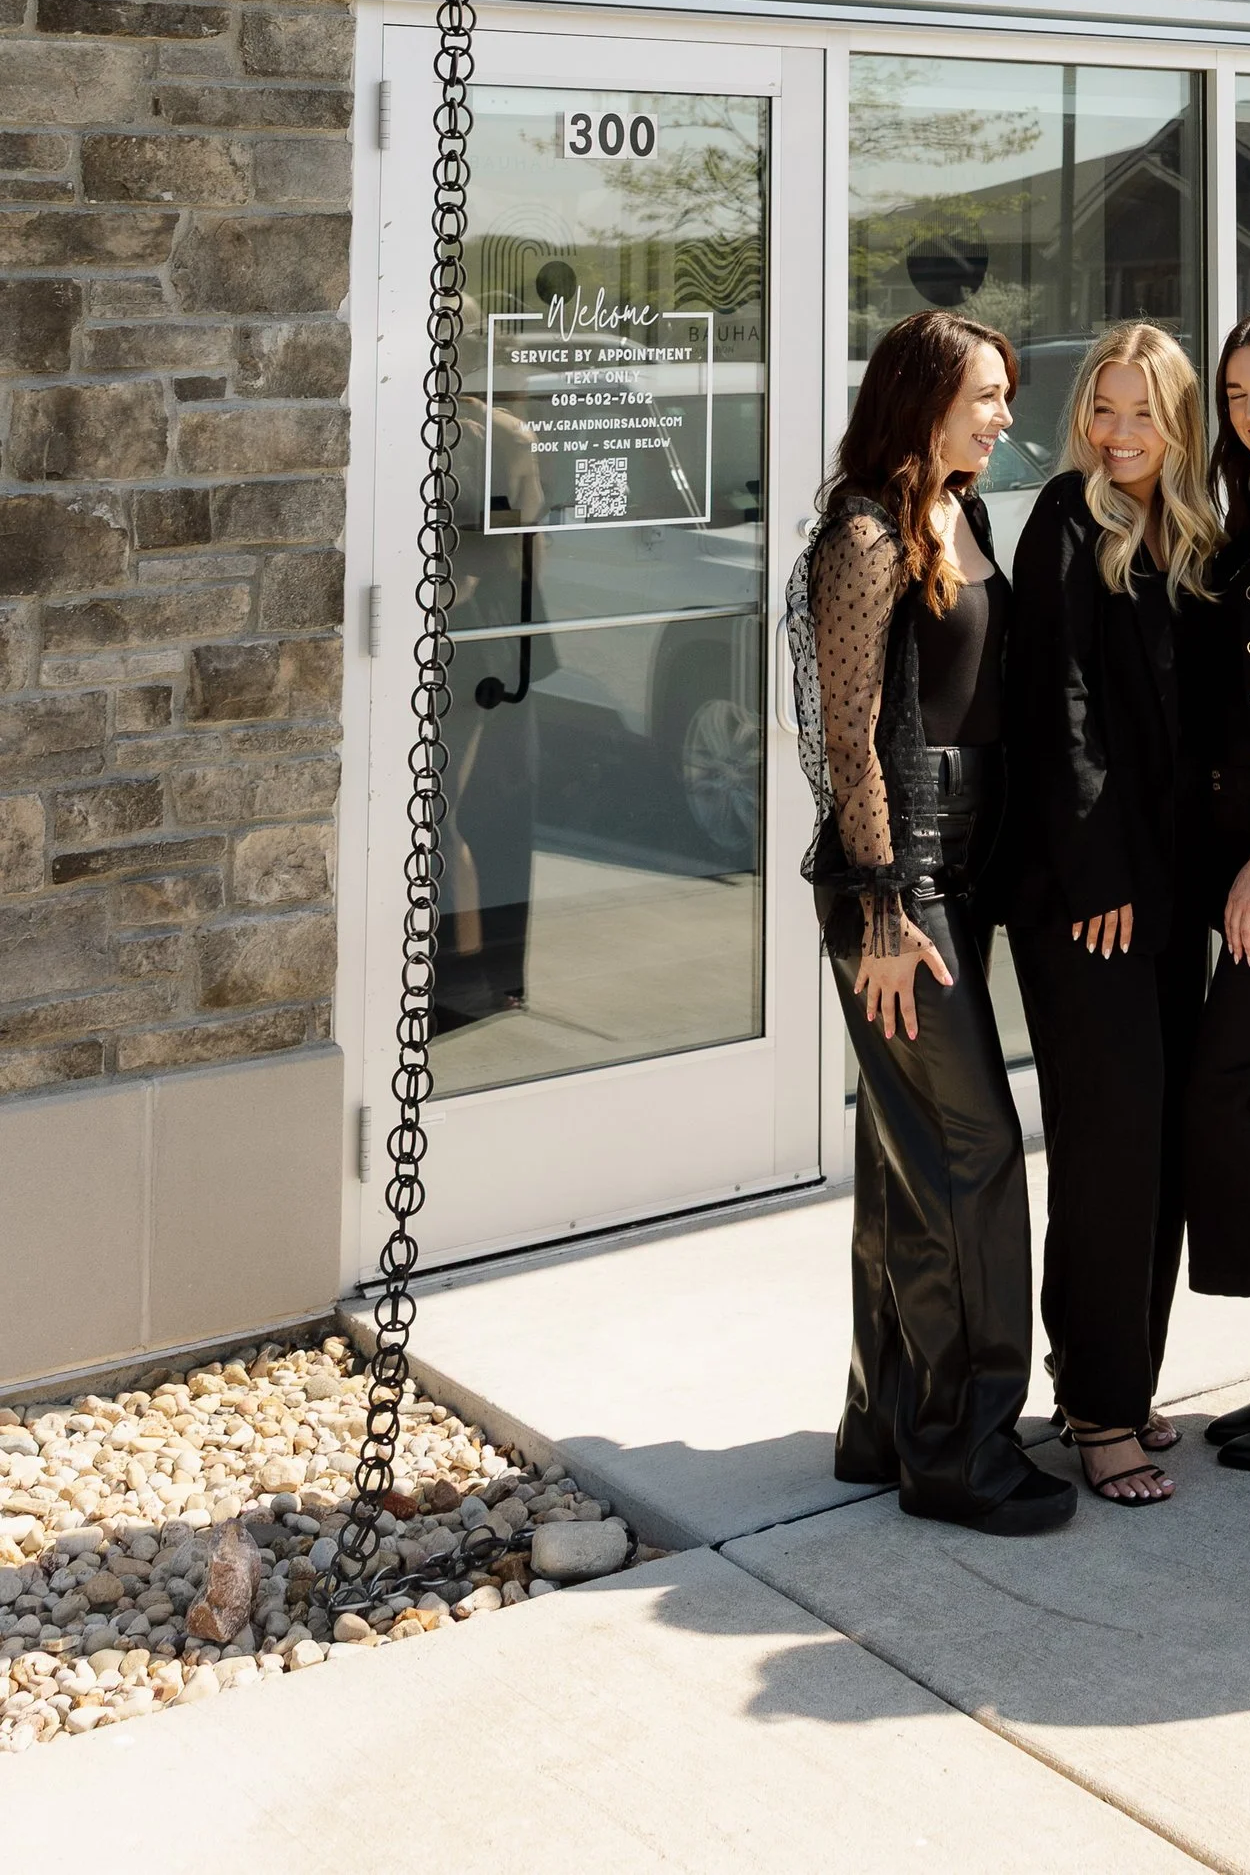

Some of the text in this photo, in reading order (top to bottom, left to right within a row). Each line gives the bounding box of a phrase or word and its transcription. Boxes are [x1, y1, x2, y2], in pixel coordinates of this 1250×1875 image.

[569, 112, 655, 157] 300
[547, 285, 660, 342] Welcome
[511, 349, 569, 364] SERVICE
[574, 348, 593, 362] BY
[597, 347, 693, 362] APPOINTMENT
[565, 370, 641, 384] TEXT ONLY
[551, 393, 653, 406] 608-602-7602
[521, 417, 682, 431] WWW.GRANDNOIRSALON.COM
[530, 442, 559, 453] BOOK
[563, 441, 589, 452] NOW
[603, 439, 631, 450] SCAN
[635, 437, 671, 449] BELOW
